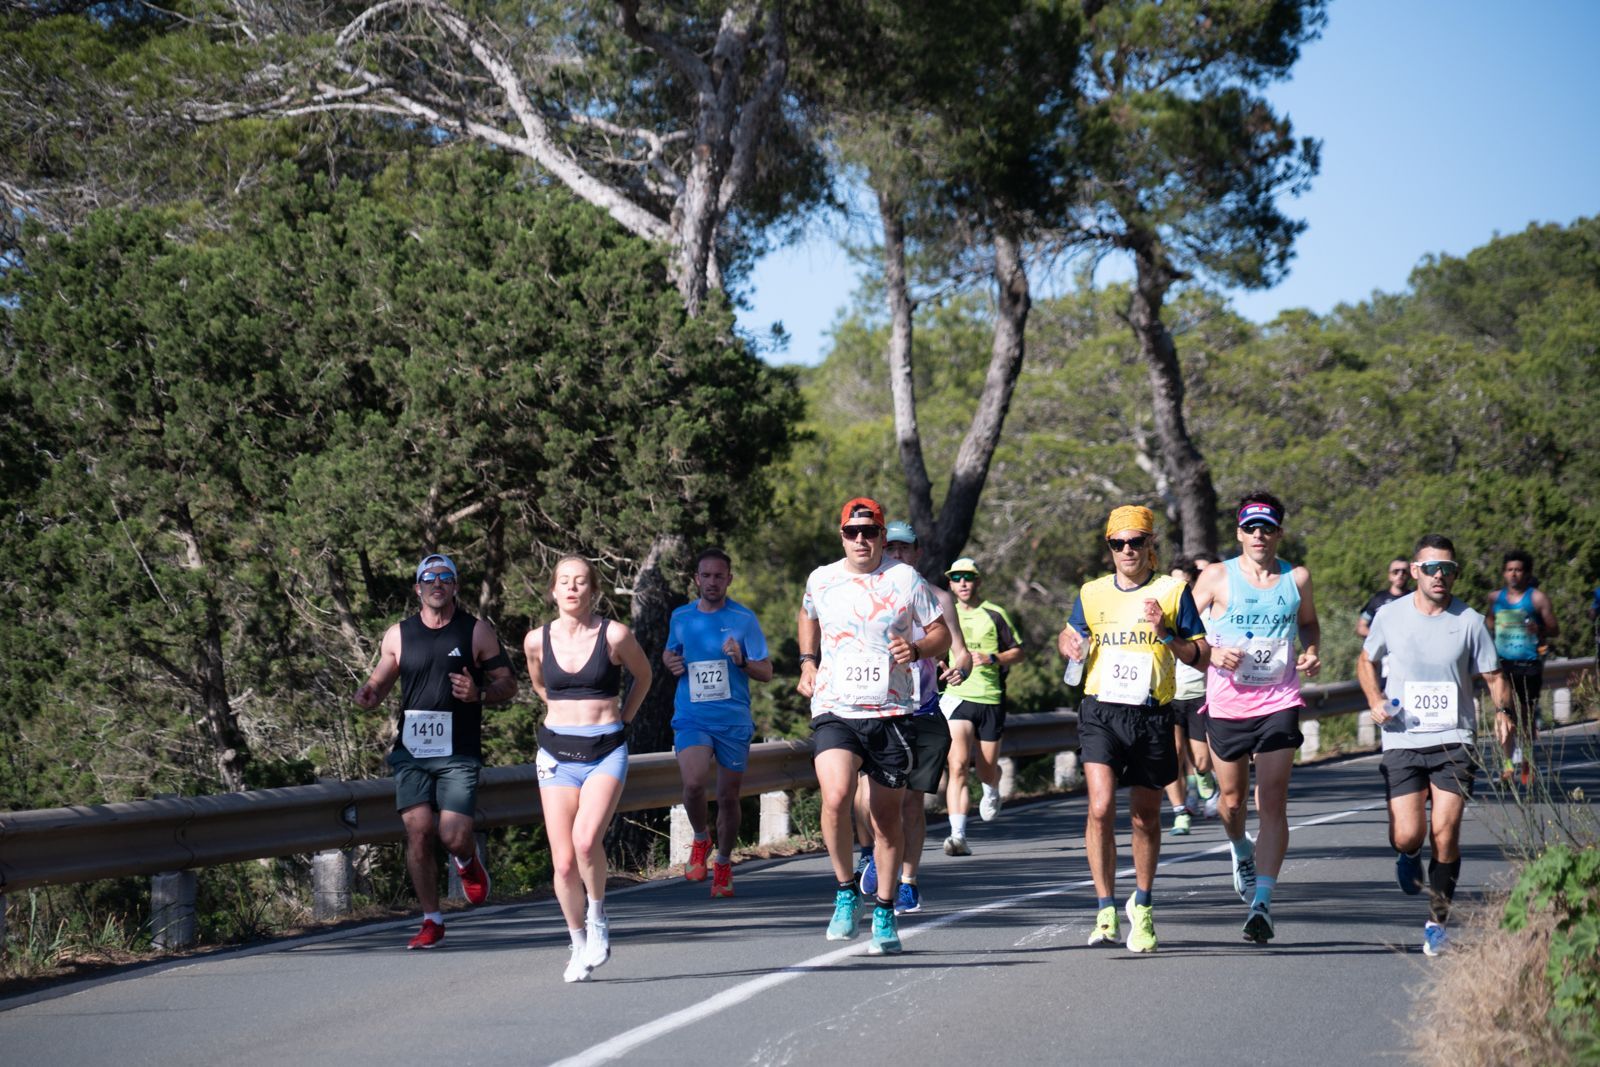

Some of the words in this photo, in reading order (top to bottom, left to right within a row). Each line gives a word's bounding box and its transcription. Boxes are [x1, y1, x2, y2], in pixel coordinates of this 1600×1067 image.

[1254, 650, 1271, 664] 32
[695, 671, 723, 684] 1272
[846, 667, 880, 681] 2315
[1112, 664, 1138, 680] 326
[1414, 695, 1448, 709] 2039
[411, 722, 444, 736] 1410
